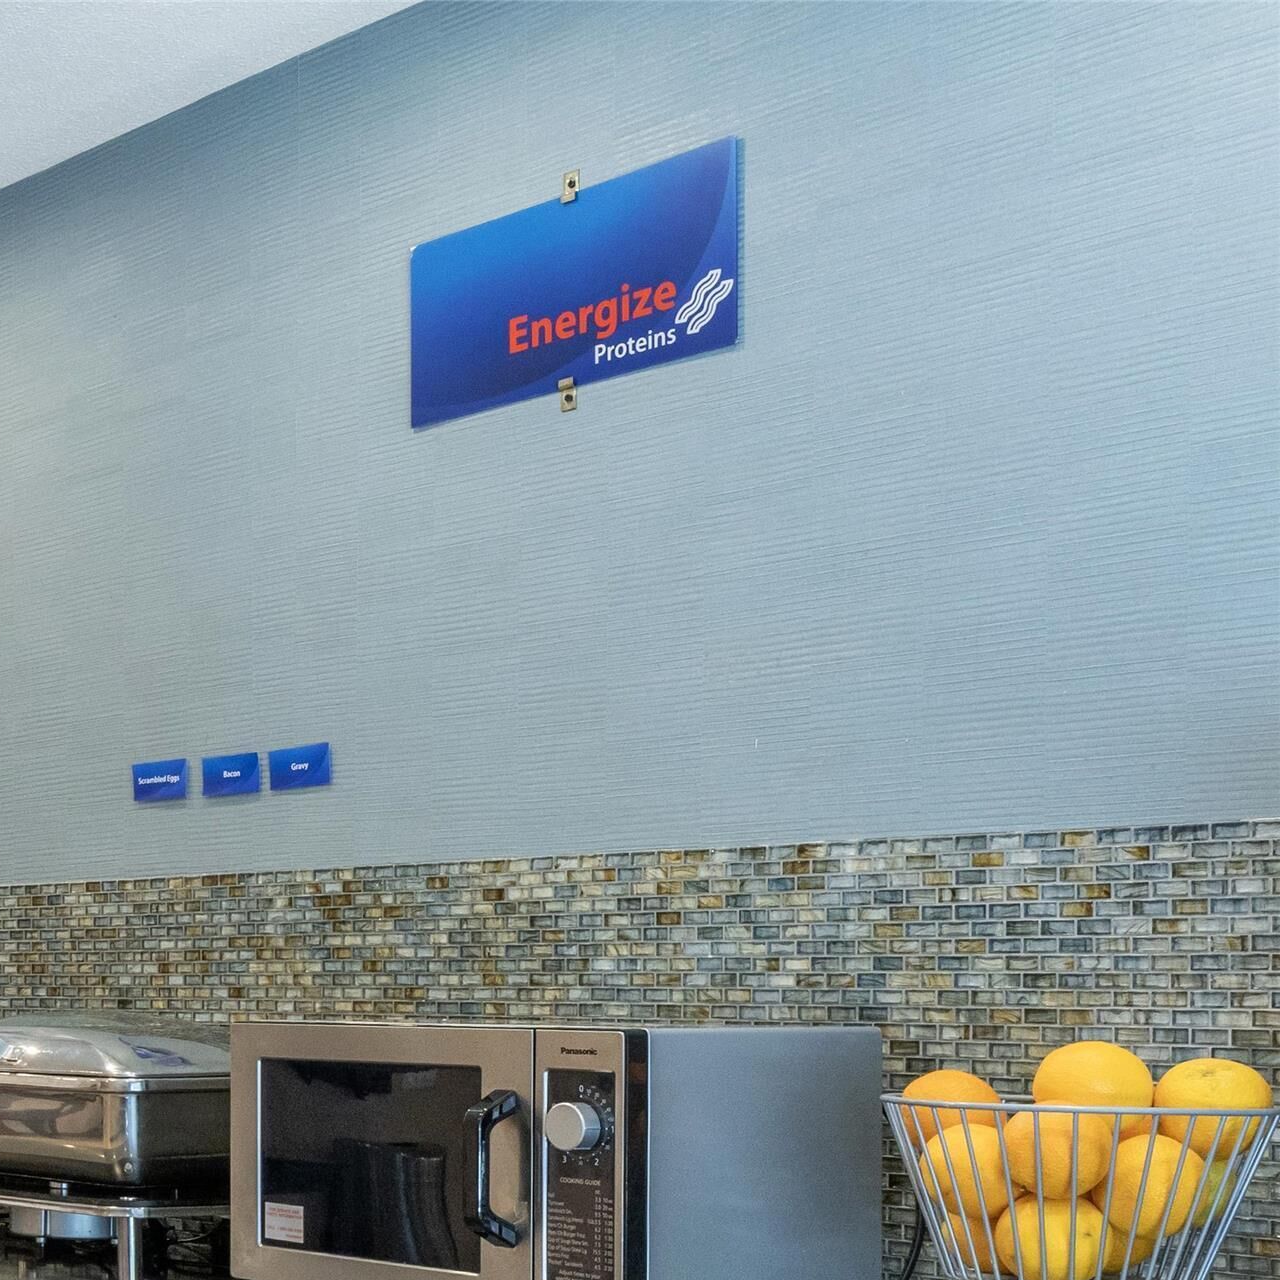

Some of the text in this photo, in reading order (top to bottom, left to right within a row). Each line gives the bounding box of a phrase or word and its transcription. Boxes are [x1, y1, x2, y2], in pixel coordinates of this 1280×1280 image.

[508, 280, 677, 355] Energize
[594, 327, 677, 365] Proteins
[290, 762, 310, 771] Gravy
[223, 769, 241, 778] Bacon
[137, 774, 180, 785] Scrambled Eggs
[560, 1047, 598, 1056] Panasonic
[579, 1084, 584, 1093] 0
[562, 1155, 567, 1163] 3
[594, 1158, 599, 1166] 2
[560, 1176, 584, 1184] COOKING
